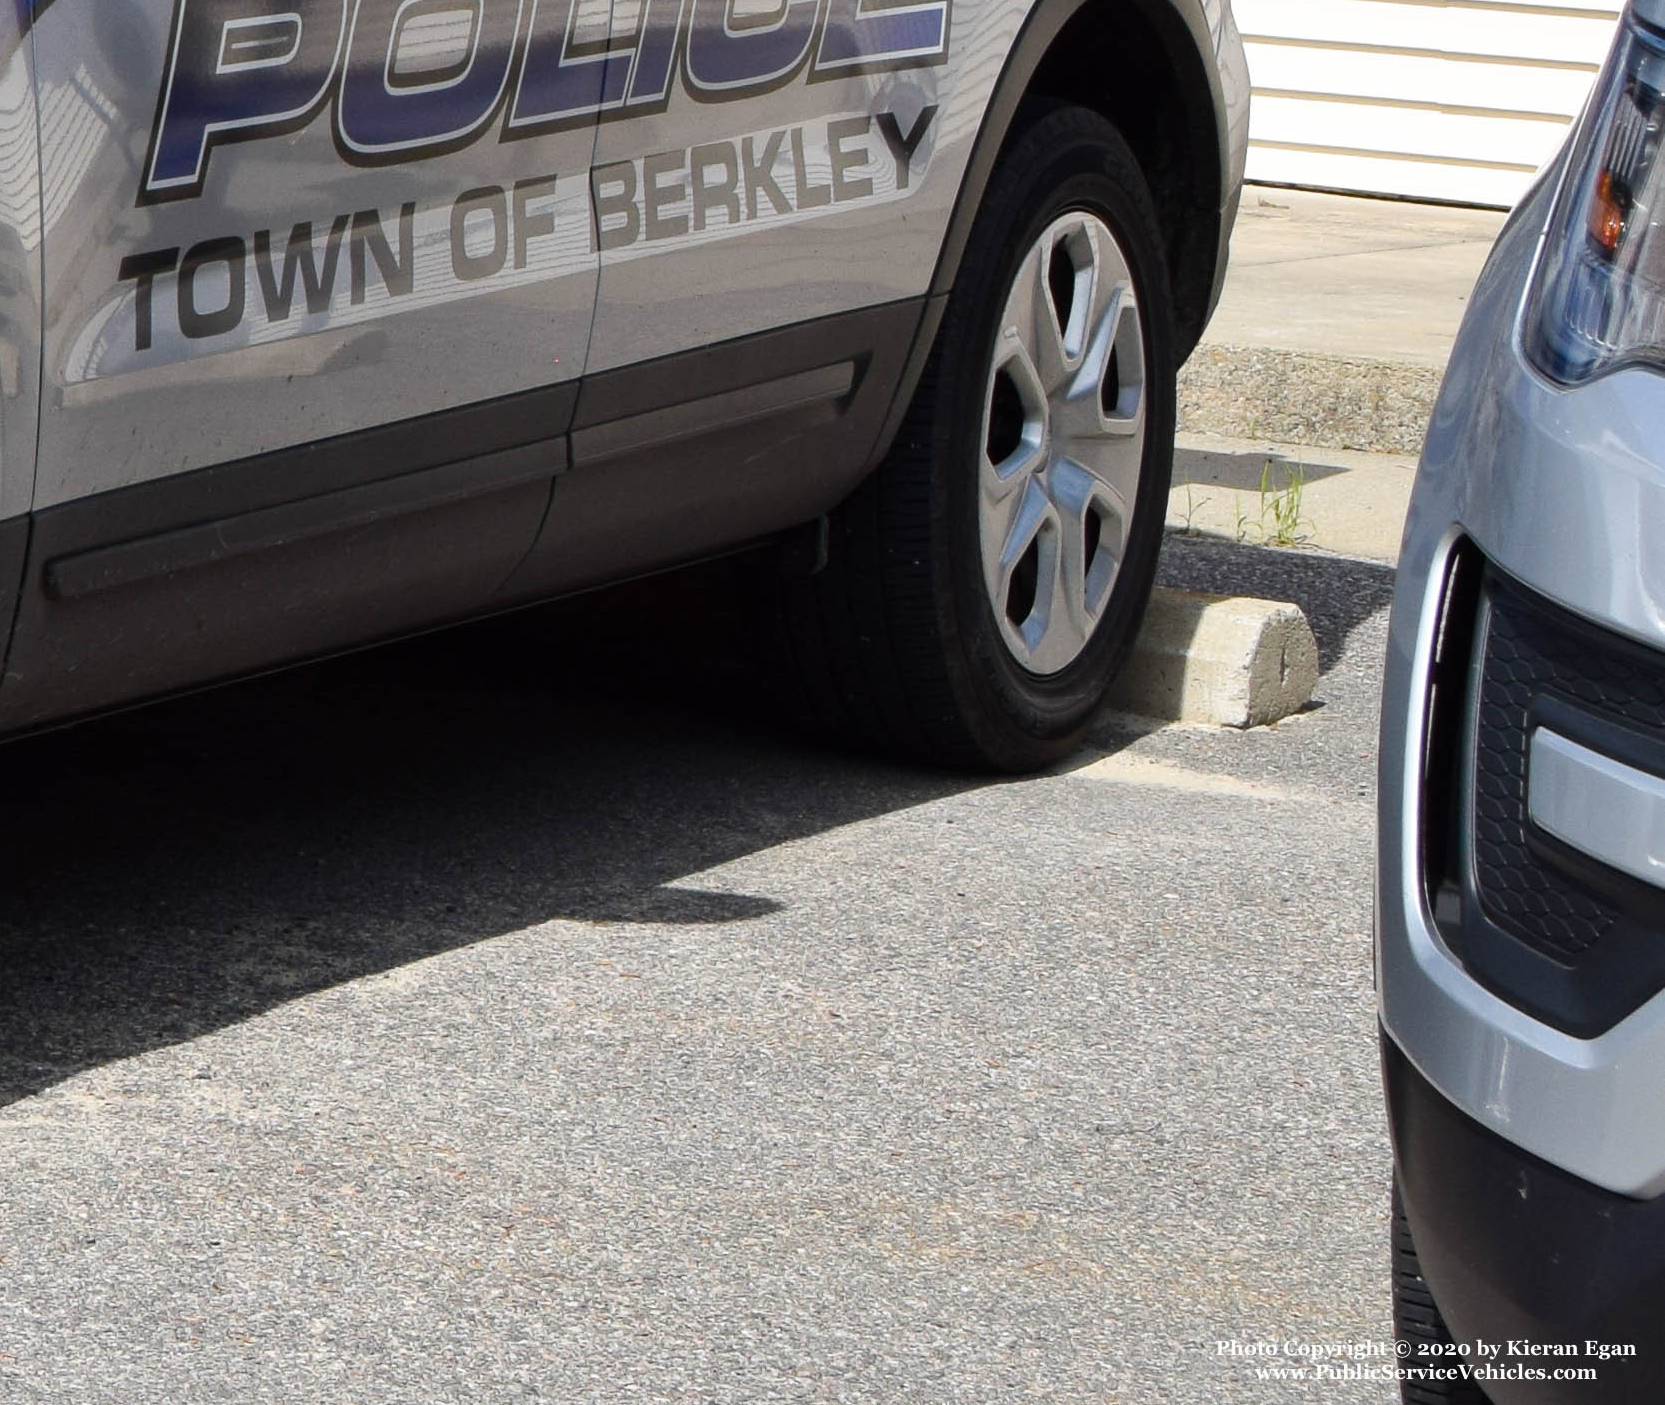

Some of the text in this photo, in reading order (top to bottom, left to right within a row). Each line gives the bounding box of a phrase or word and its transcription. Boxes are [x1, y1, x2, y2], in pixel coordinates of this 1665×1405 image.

[117, 105, 939, 352] TOWN OF BERKLEY
